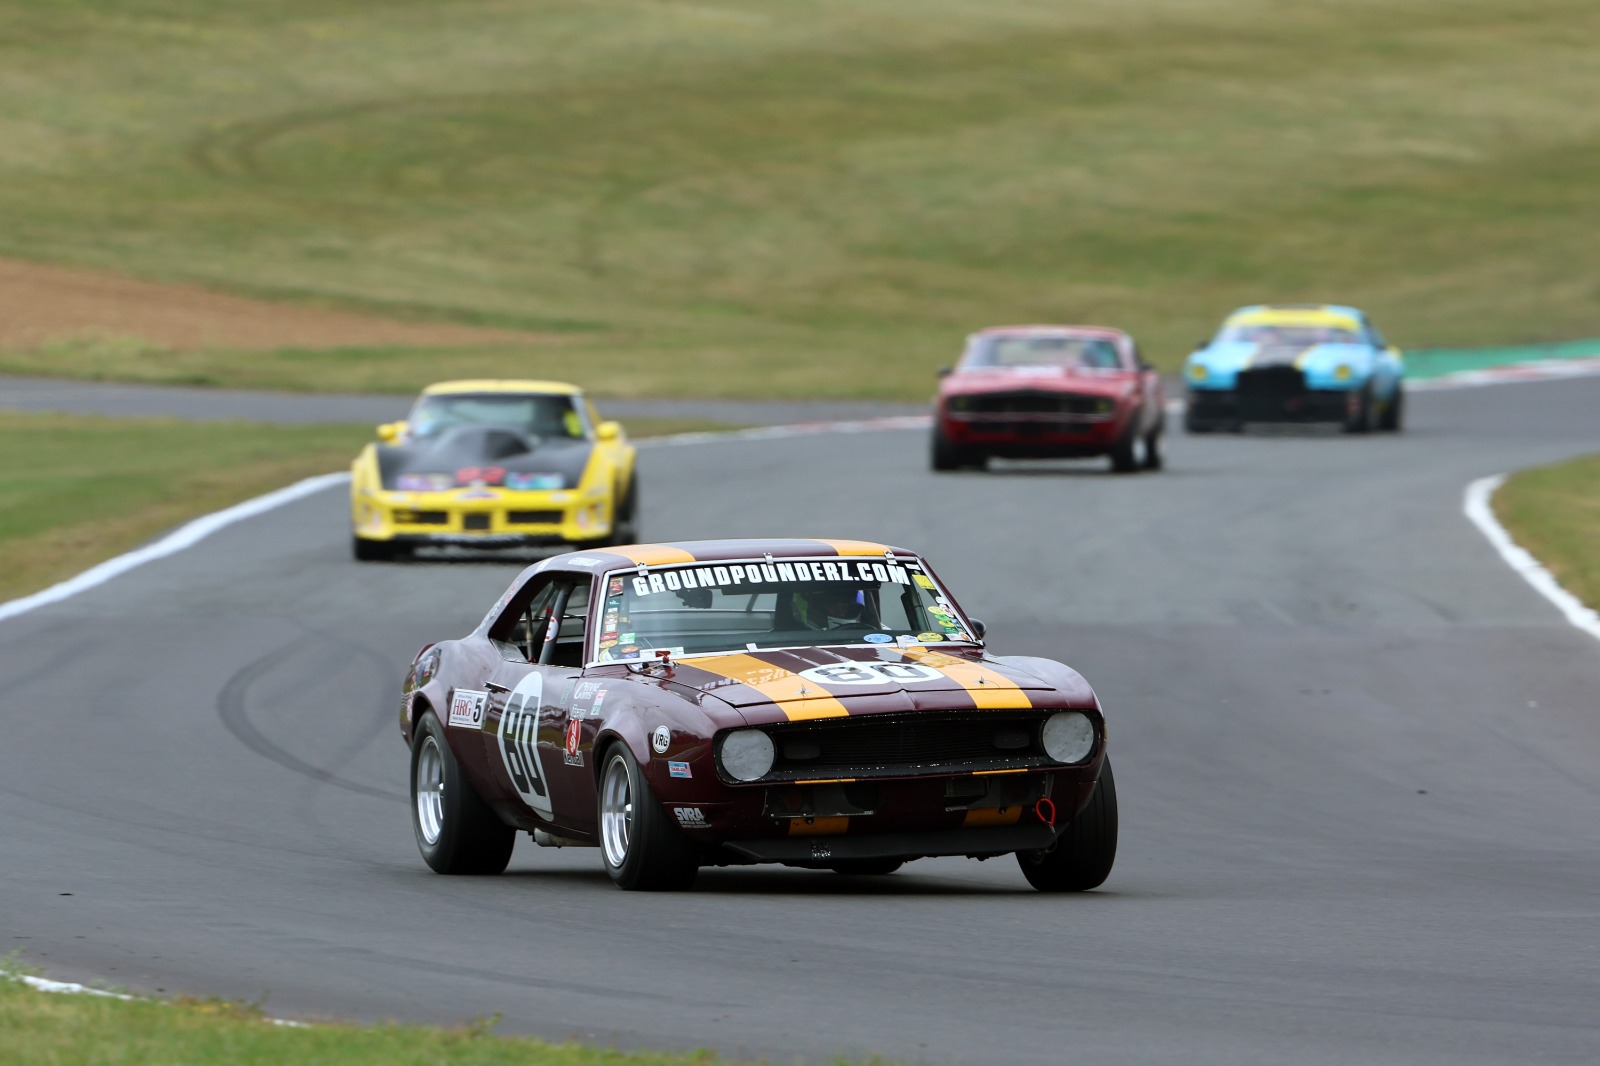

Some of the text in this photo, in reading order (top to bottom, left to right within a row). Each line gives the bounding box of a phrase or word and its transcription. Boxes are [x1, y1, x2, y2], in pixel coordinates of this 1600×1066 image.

[631, 562, 910, 597] GROUNDPOUNDERZ.COM
[814, 664, 930, 683] 80
[452, 697, 484, 723] HRG 5
[502, 692, 547, 798] 80
[655, 733, 669, 747] VRG
[673, 807, 705, 821] SVRA
